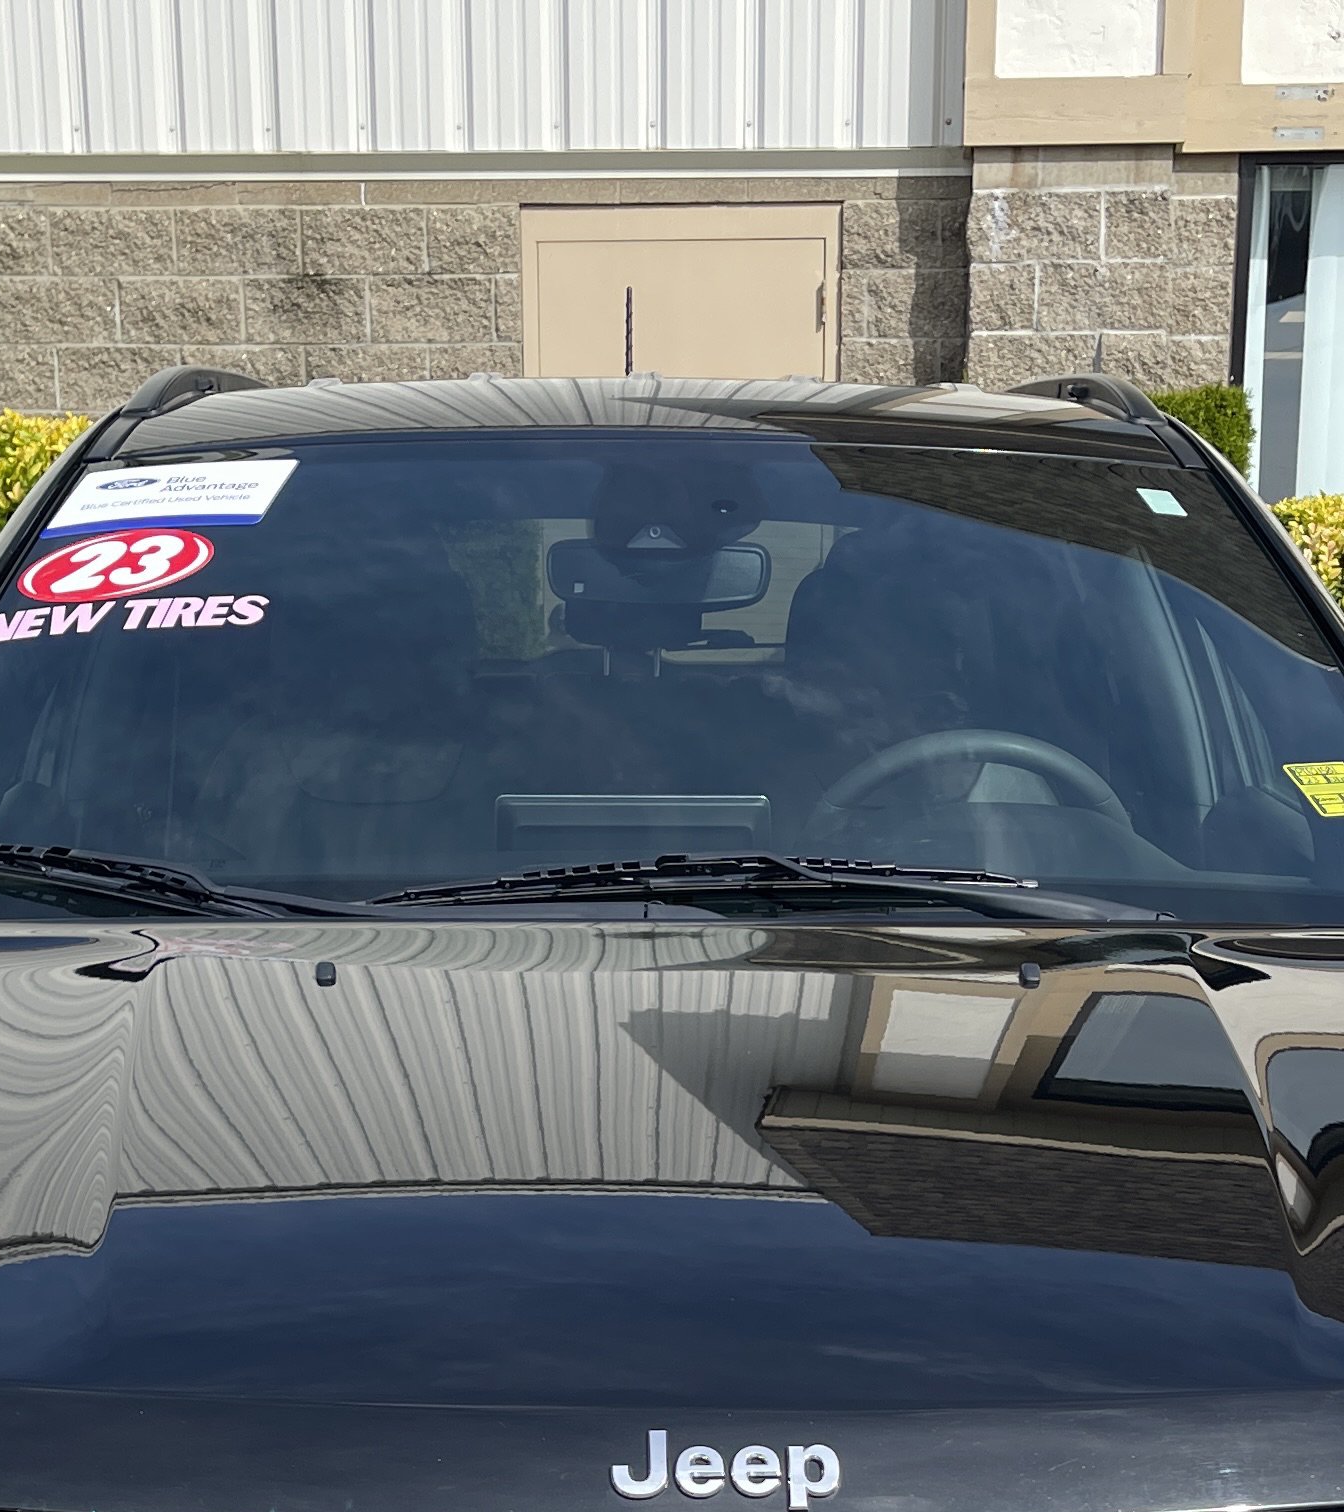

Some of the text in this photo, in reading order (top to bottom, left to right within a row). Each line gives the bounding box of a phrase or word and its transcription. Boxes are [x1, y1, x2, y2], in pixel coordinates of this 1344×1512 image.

[159, 481, 260, 493] Advantage
[166, 475, 207, 485] Blue
[50, 534, 185, 594] 23
[123, 595, 270, 630] TIRES
[610, 1429, 841, 1512] Jeep
